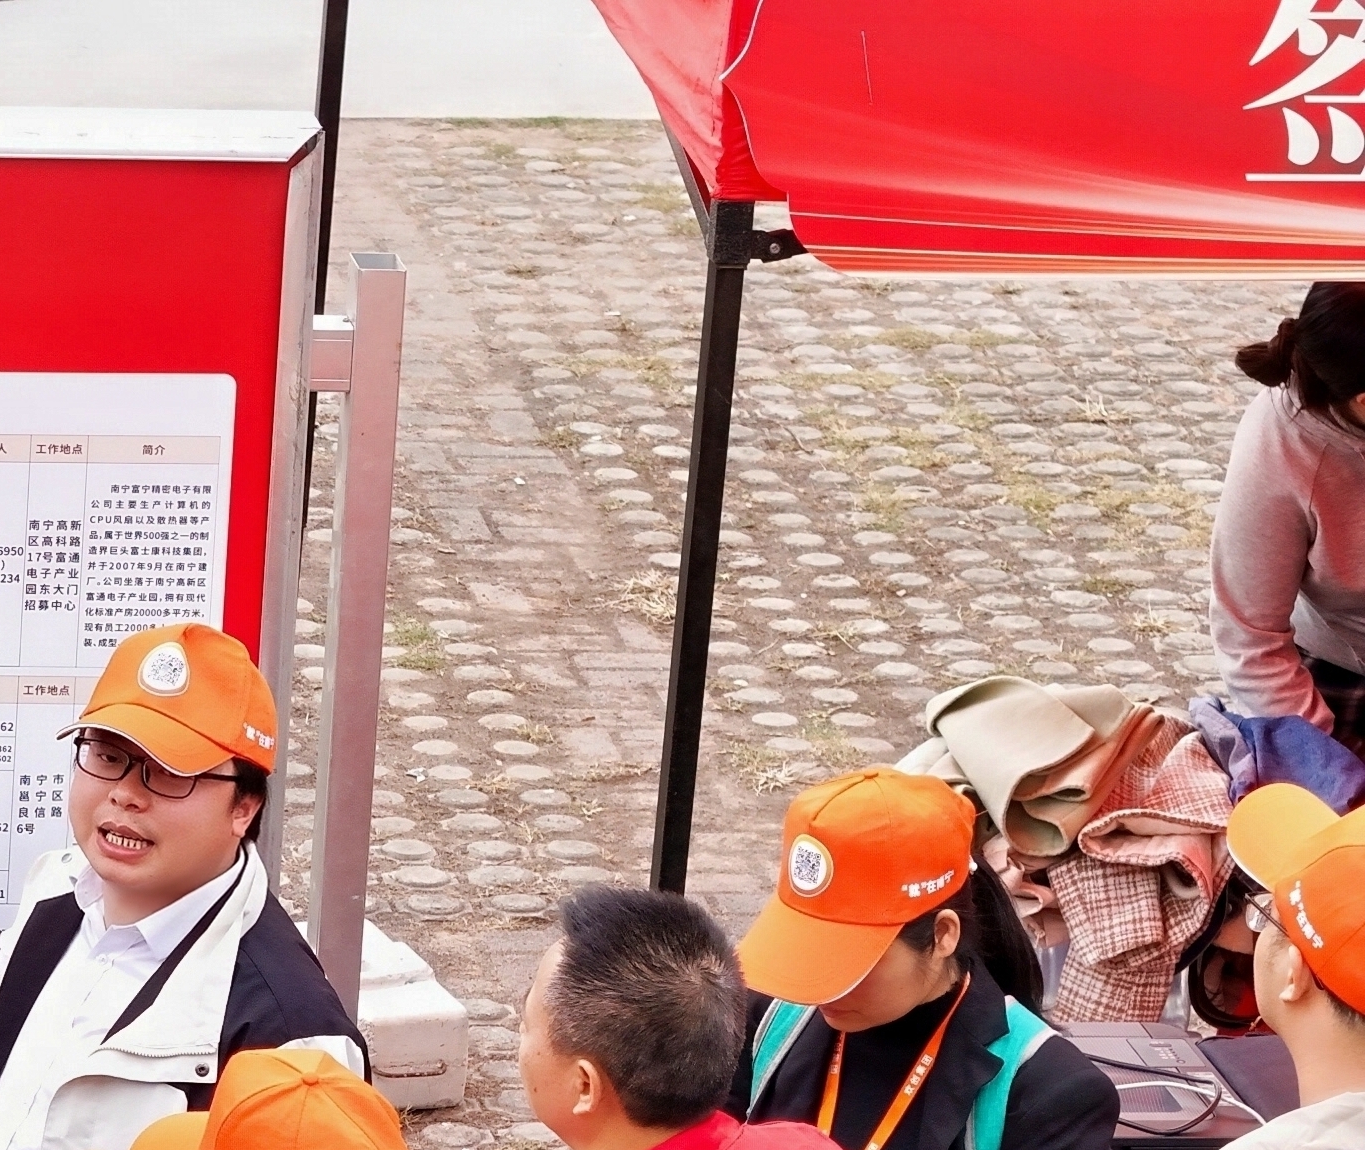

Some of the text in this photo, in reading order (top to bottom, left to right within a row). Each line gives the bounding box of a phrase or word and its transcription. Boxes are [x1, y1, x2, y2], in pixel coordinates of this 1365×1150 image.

[29, 520, 81, 531] 南宁高新
[25, 600, 75, 611] 招募中心
[17, 824, 35, 834] 6号
